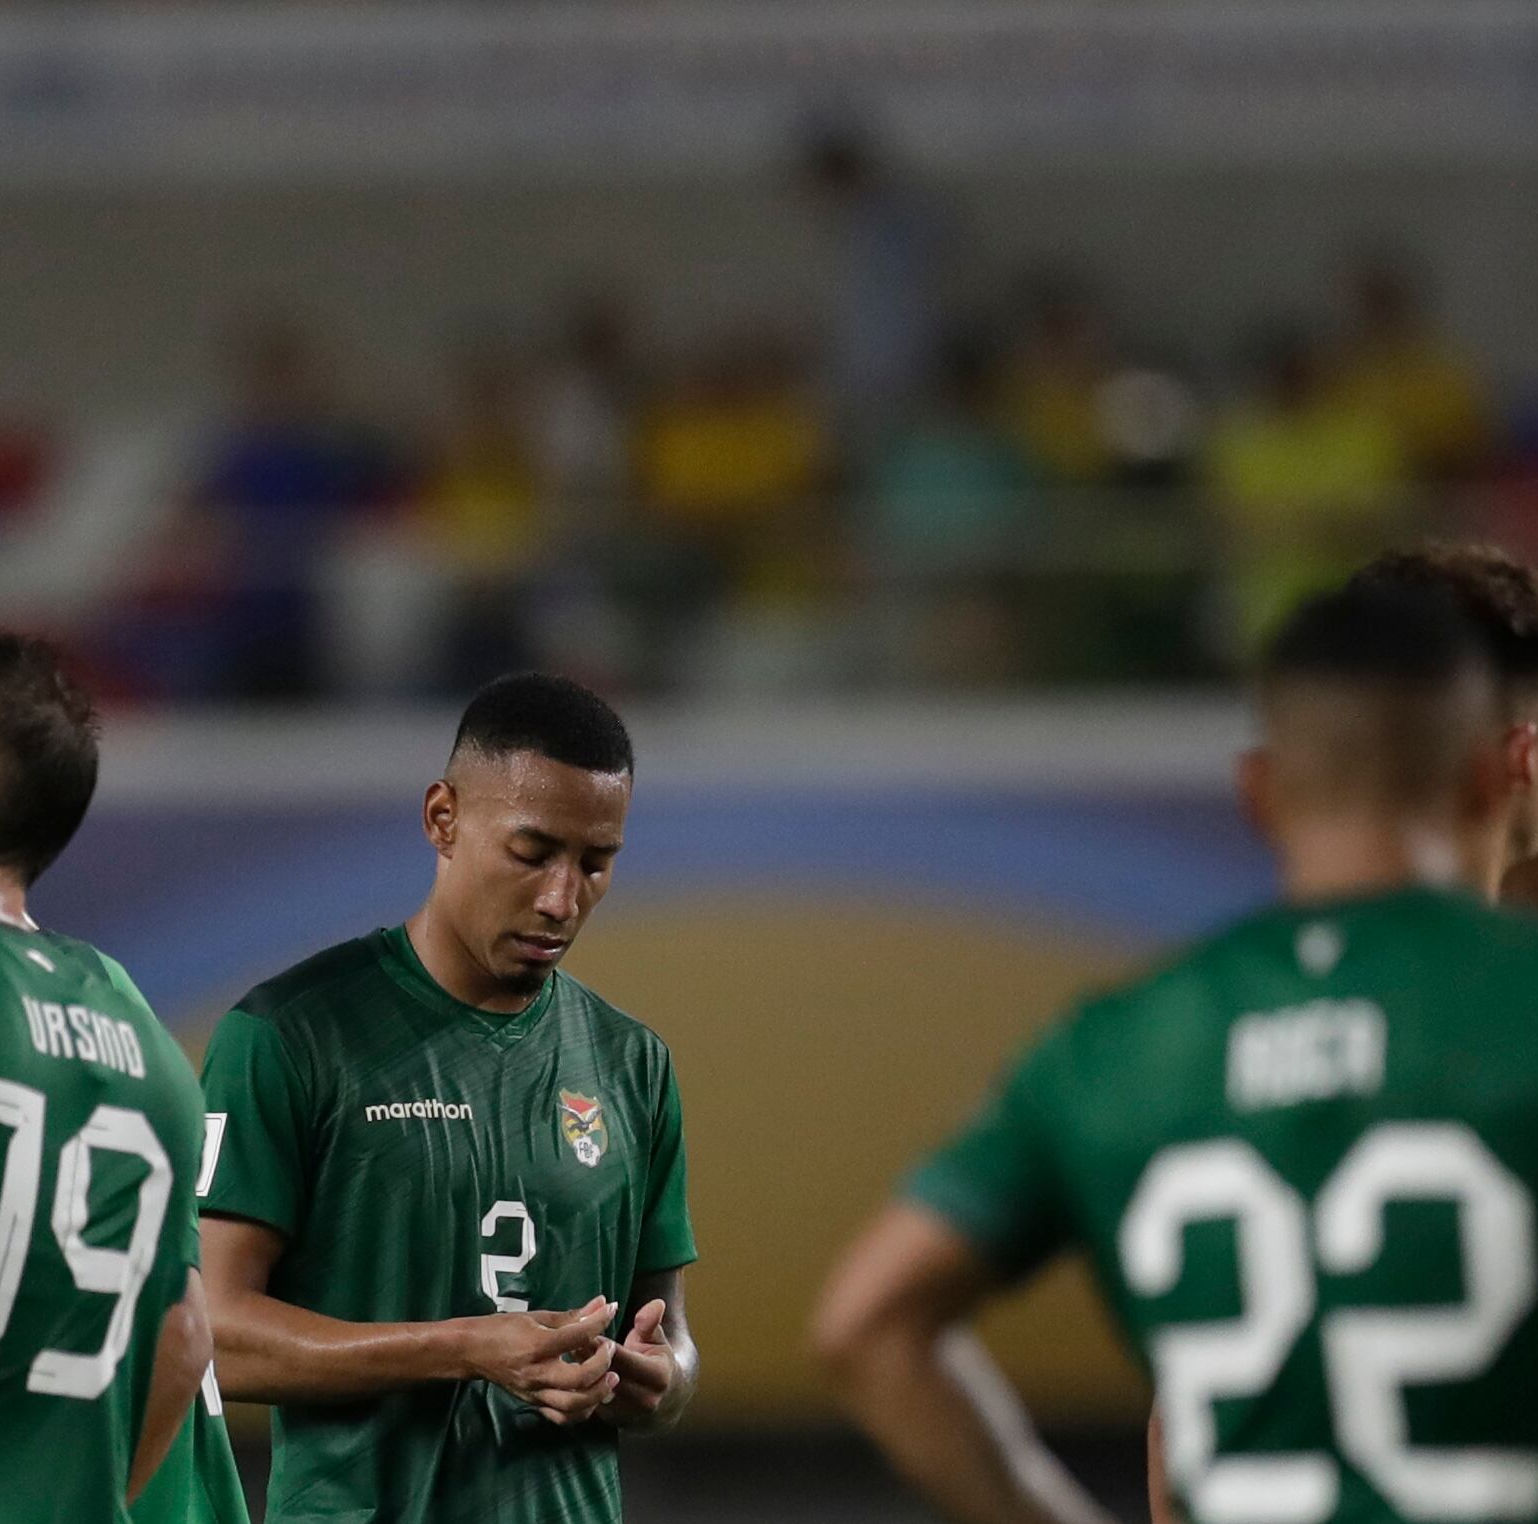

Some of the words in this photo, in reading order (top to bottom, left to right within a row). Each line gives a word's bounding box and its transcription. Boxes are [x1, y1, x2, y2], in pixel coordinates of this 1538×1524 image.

[22, 996, 147, 1080] URSINO
[365, 1099, 473, 1122] marathon
[481, 1200, 537, 1313] 2
